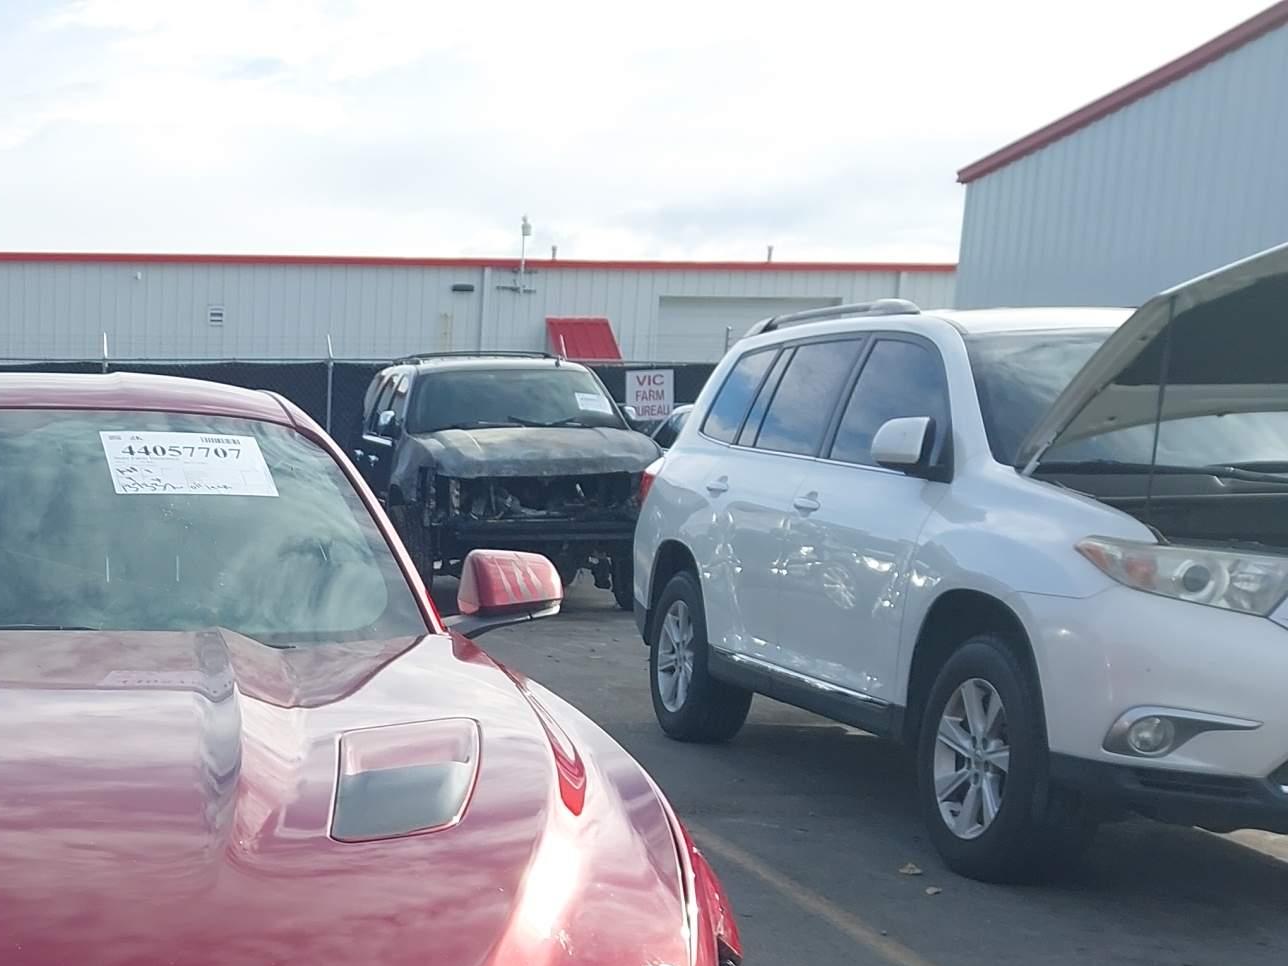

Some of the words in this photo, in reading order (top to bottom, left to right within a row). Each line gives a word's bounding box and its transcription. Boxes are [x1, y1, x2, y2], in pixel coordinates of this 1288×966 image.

[636, 374, 665, 386] VIC
[636, 390, 665, 402] FARM
[121, 445, 241, 460] 44057707
